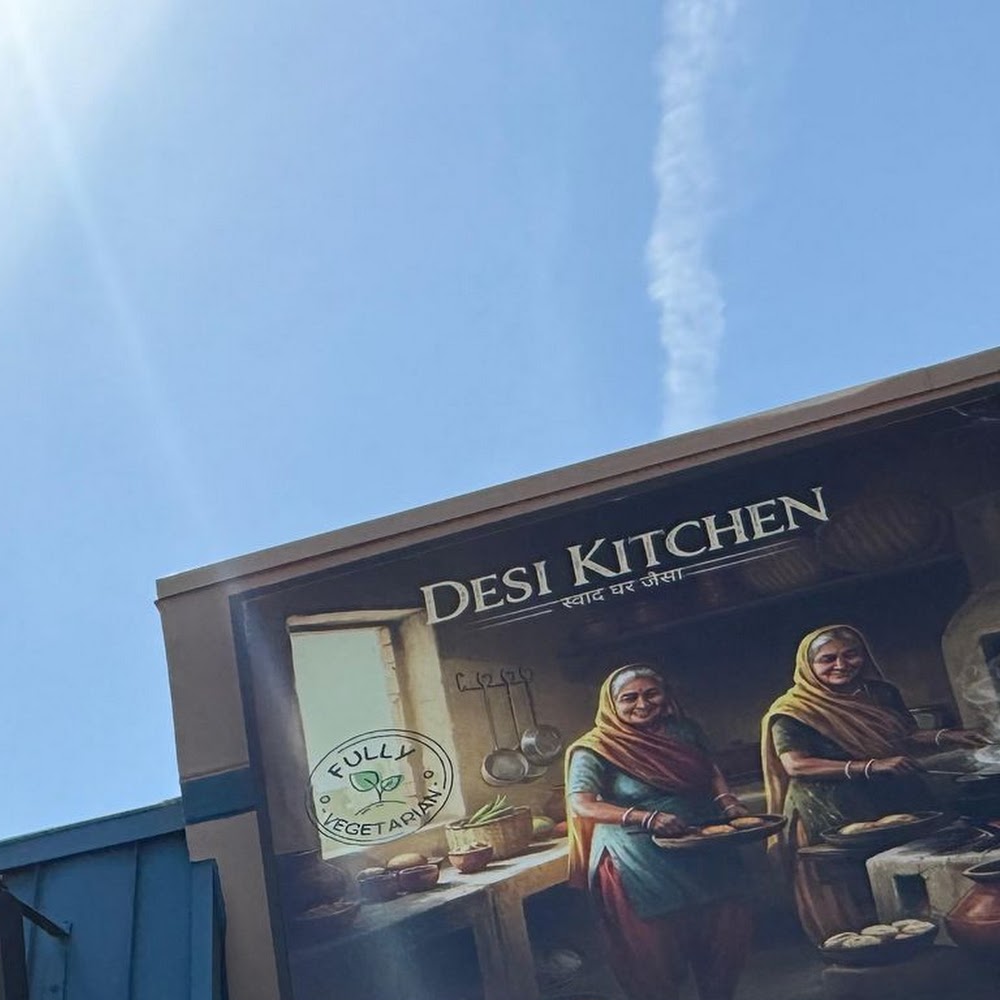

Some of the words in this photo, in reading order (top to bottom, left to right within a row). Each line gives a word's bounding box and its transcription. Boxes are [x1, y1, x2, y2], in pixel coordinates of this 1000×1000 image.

[419, 559, 553, 625] DESI
[565, 486, 831, 586] KITCHEN
[560, 587, 605, 608] स्वाद
[609, 579, 635, 595] घर
[327, 743, 416, 779] FULLY
